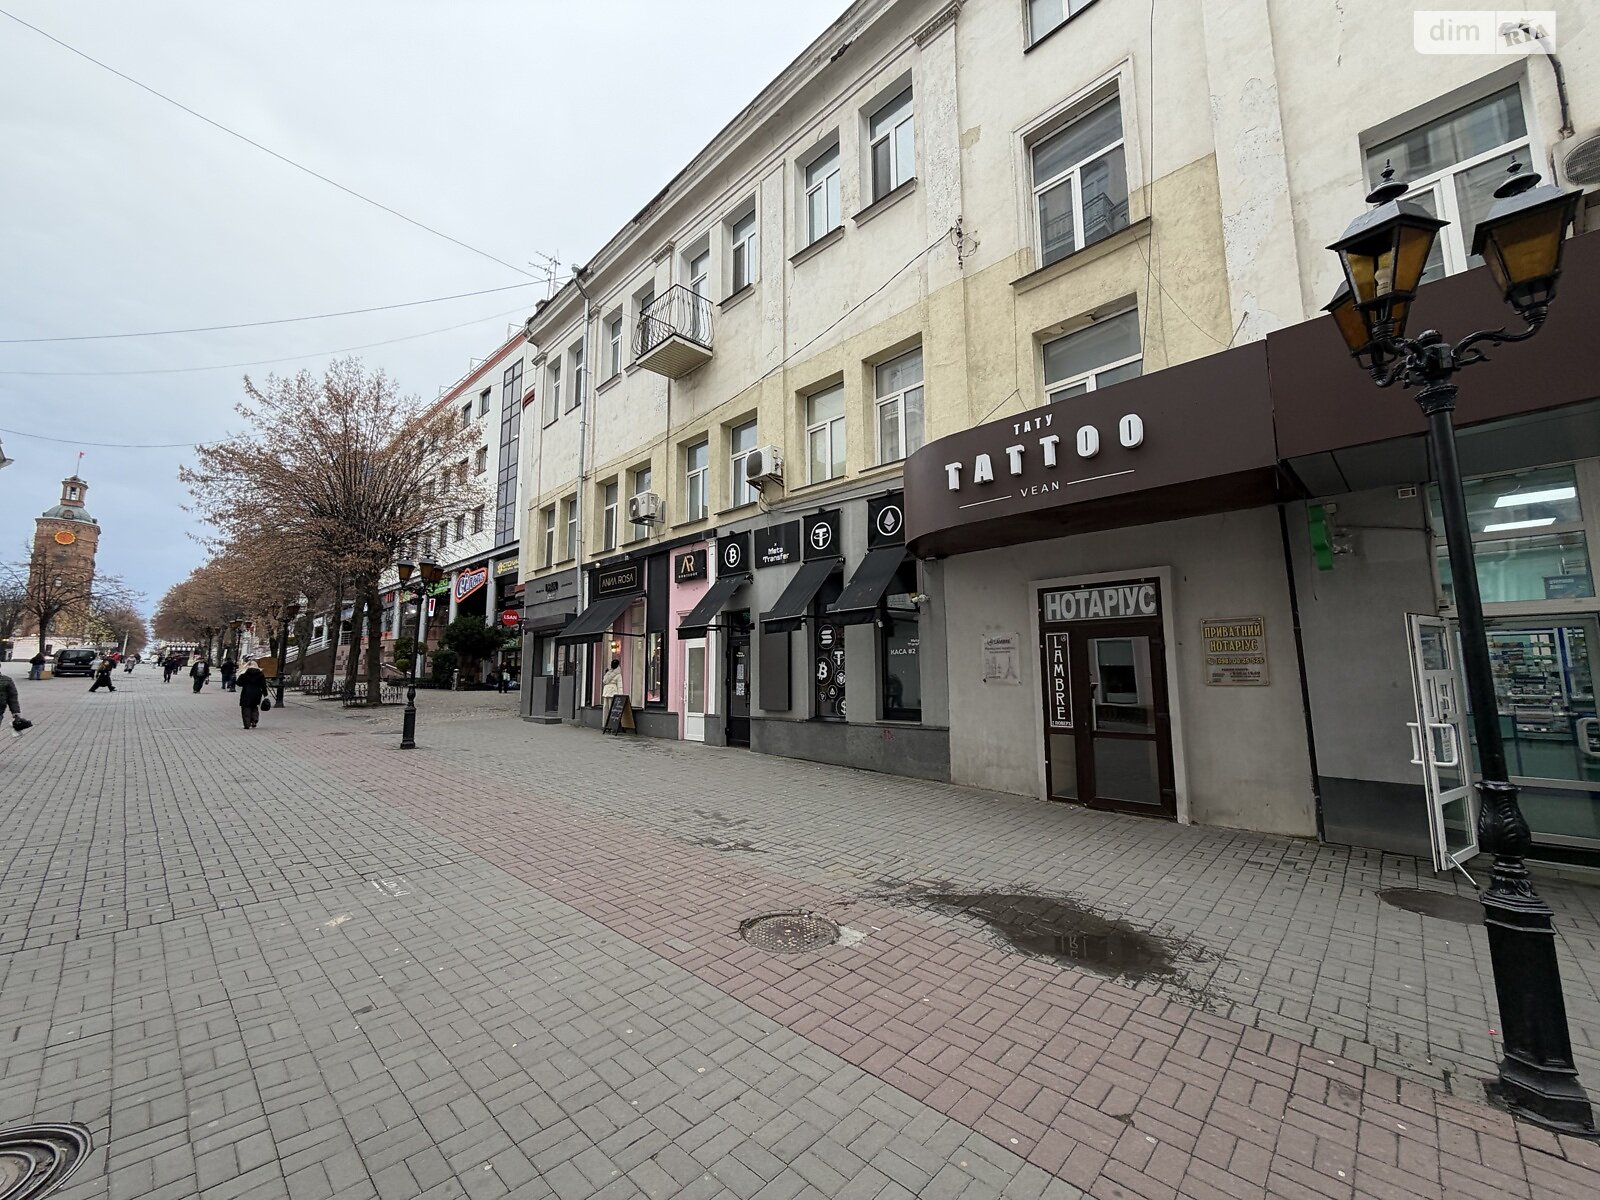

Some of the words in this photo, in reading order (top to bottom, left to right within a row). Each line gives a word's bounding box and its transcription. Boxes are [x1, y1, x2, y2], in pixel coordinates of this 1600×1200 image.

[1013, 413, 1053, 436] ТАТУ
[945, 413, 1144, 491] TATTOO
[1020, 481, 1060, 497] VEAN
[763, 553, 790, 563] Transfer
[768, 547, 784, 555] Meta
[618, 573, 634, 584] ROSA
[1046, 585, 1156, 620] НОТАРІУС
[1204, 622, 1261, 638] ПРИВАТНИЙ
[1210, 640, 1259, 652] НОТАРІУС
[1053, 636, 1066, 720] LAMBRE
